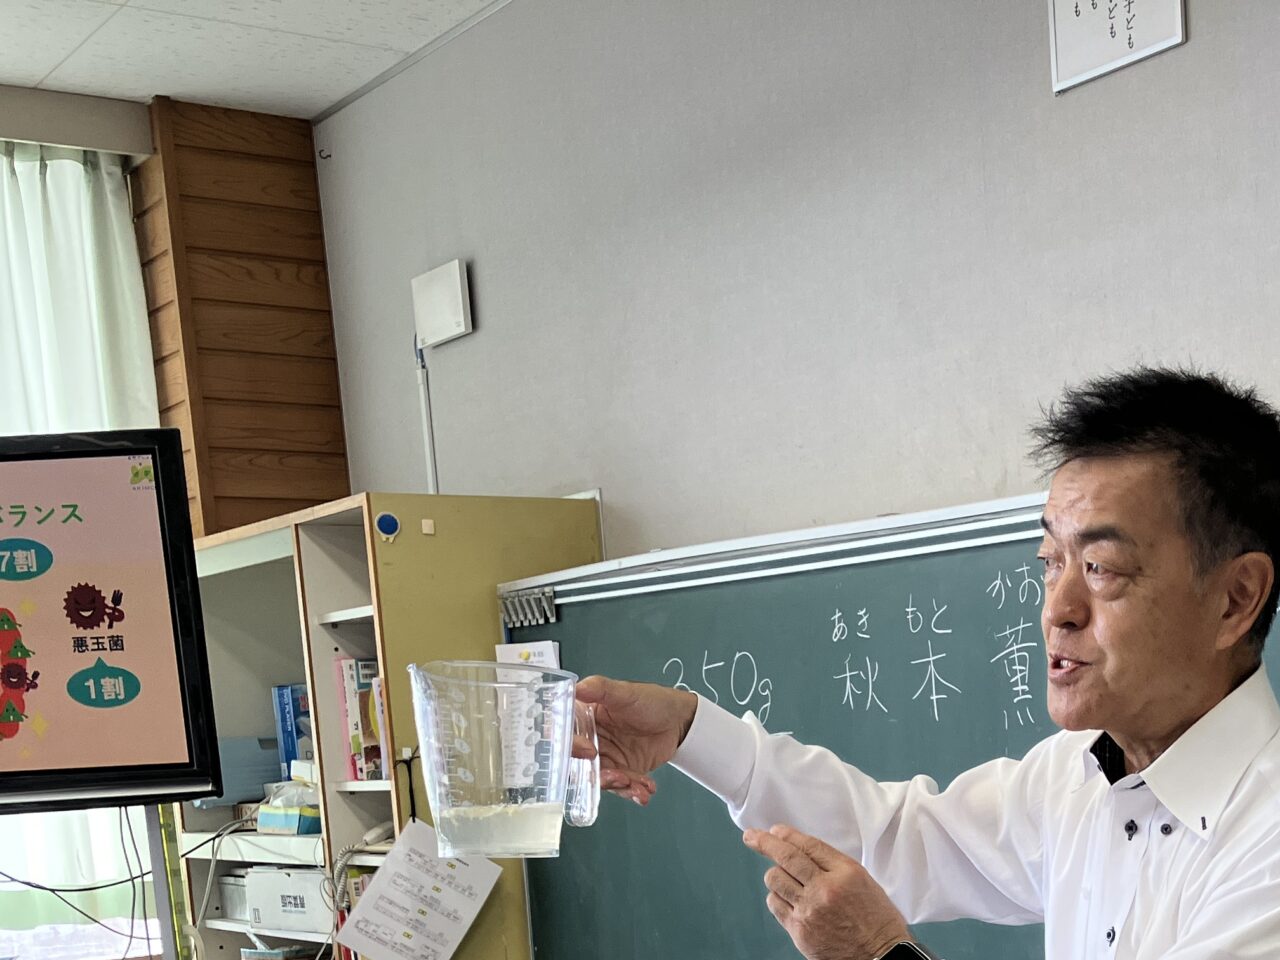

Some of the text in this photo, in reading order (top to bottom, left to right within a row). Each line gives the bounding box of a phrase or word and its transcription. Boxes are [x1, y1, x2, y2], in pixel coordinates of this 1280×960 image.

[1108, 0, 1118, 39] ども
[0, 503, 84, 527] ランス
[72, 635, 125, 653] 悪玉菌
[84, 676, 126, 700] 1割
